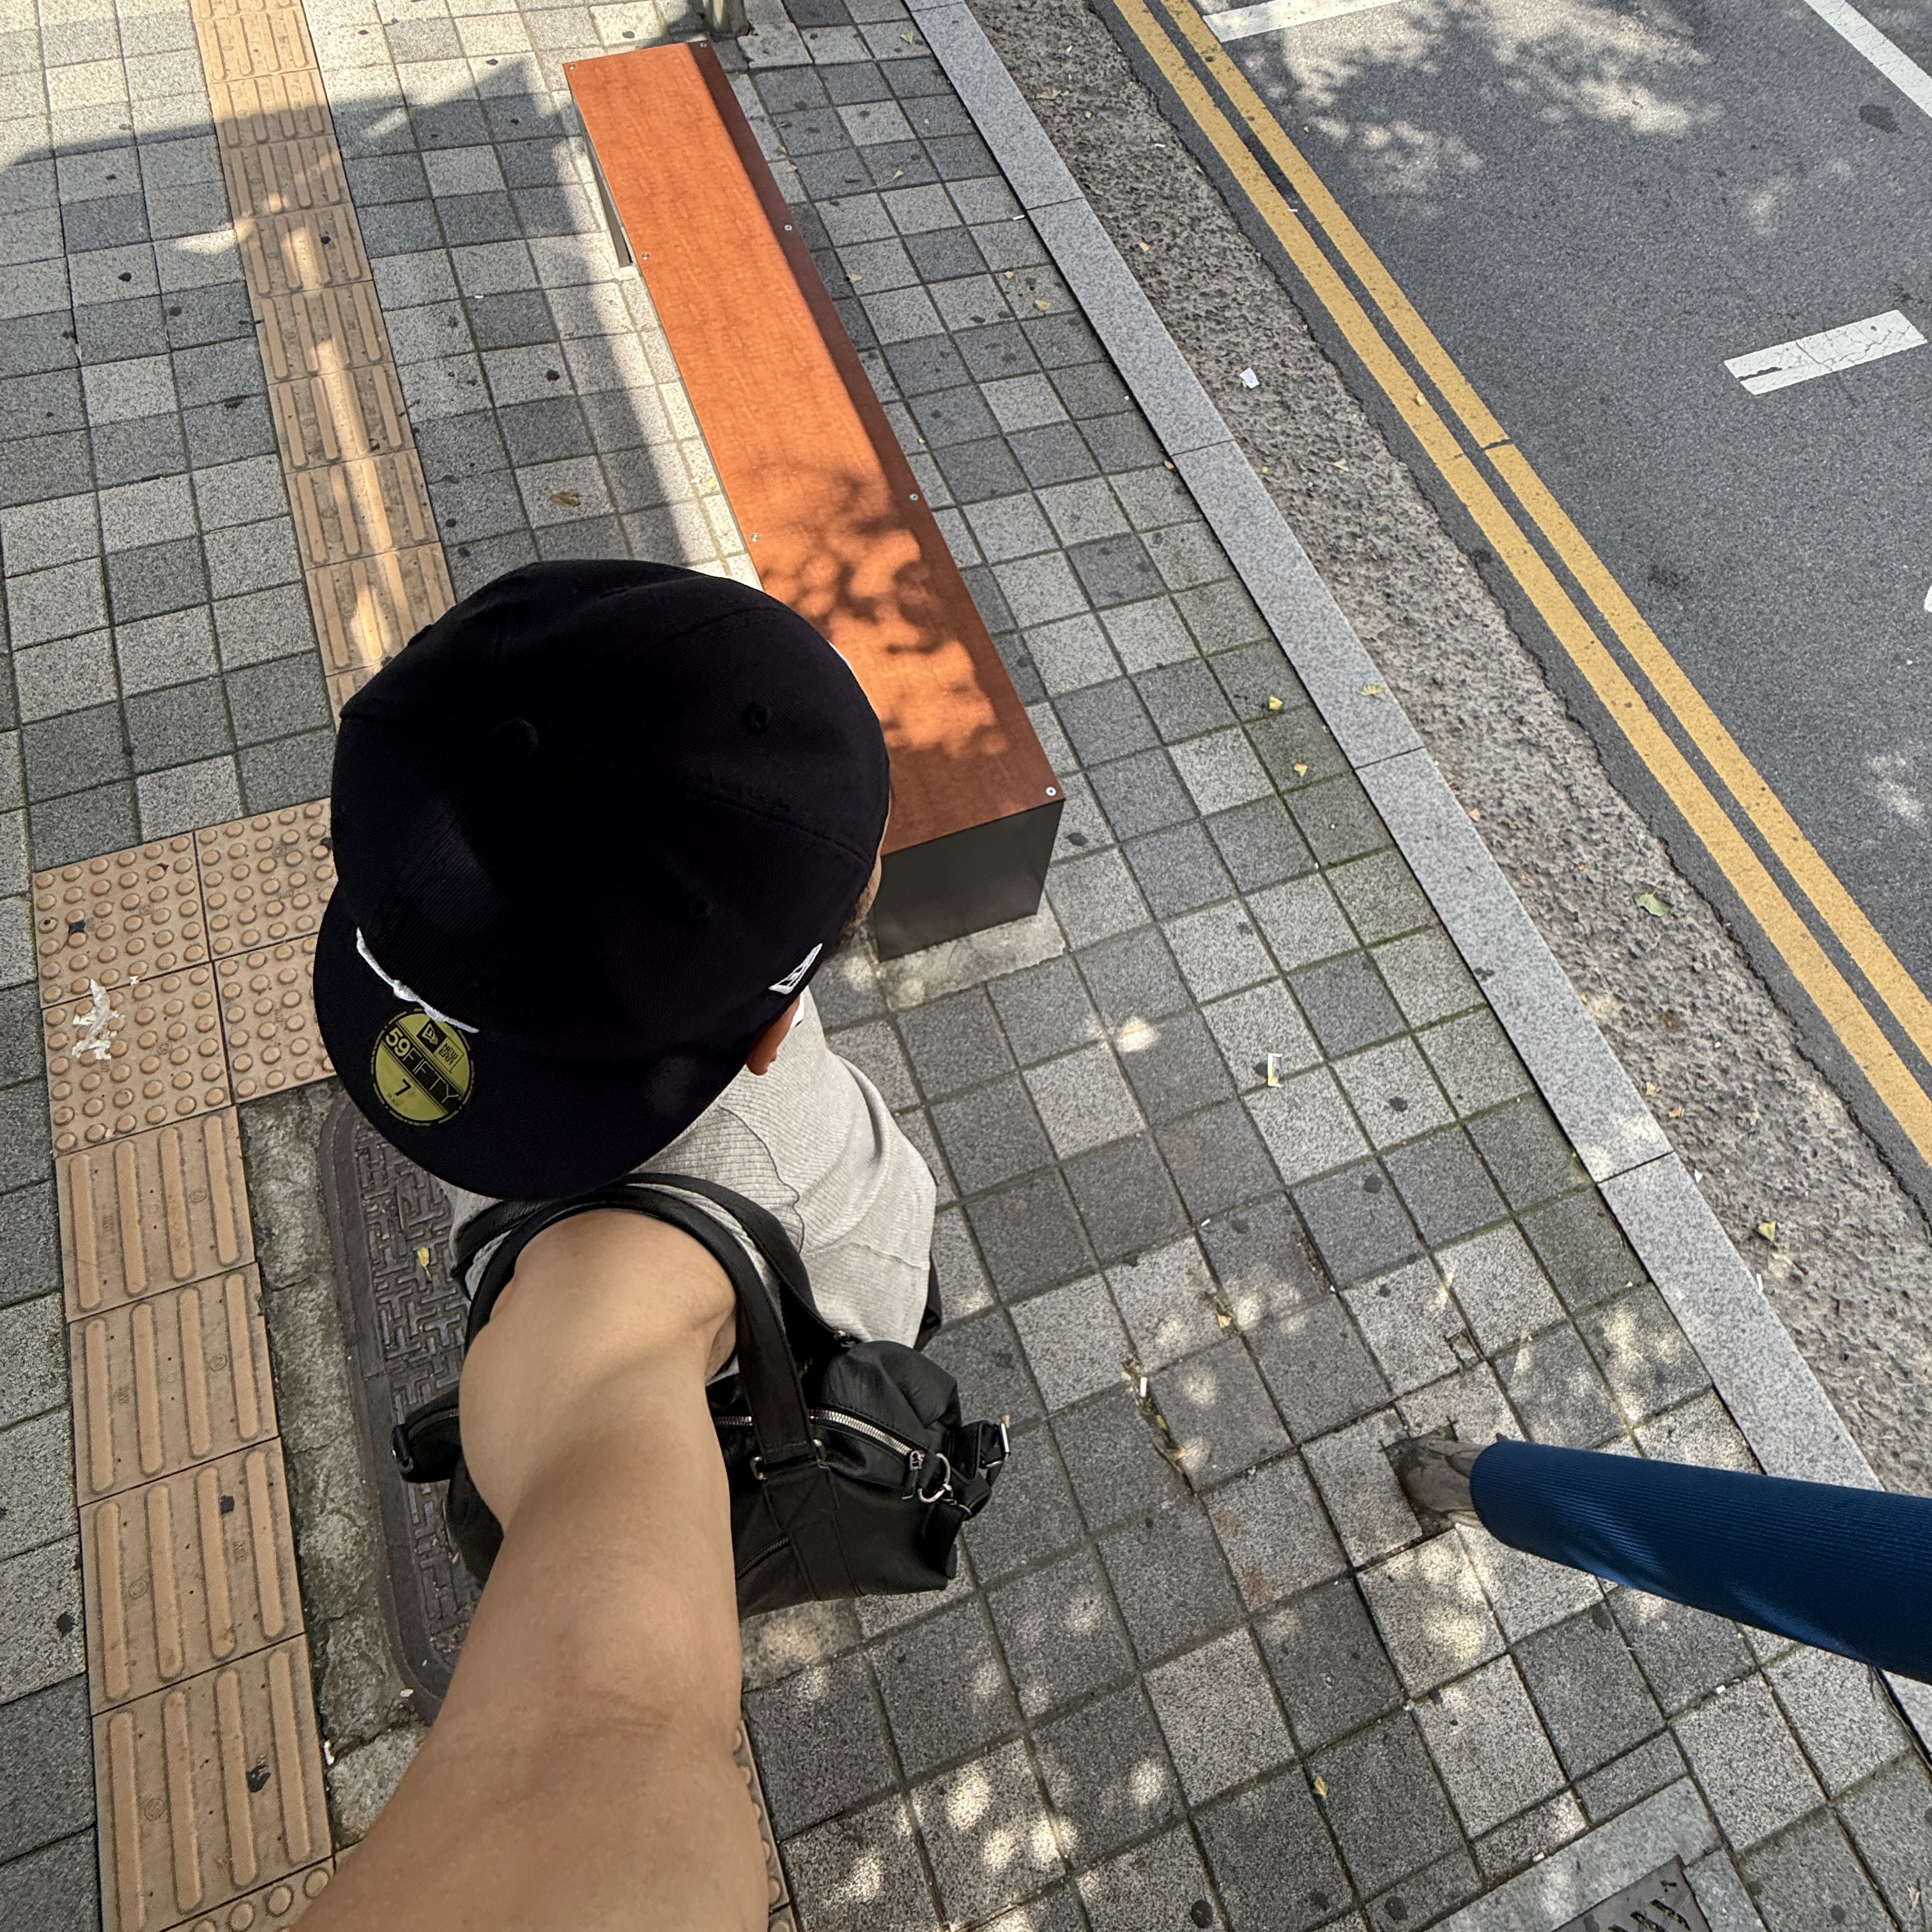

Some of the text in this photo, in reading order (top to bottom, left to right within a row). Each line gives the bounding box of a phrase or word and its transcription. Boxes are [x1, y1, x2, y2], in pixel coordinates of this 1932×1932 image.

[438, 1048, 455, 1066] ERA
[442, 1043, 459, 1060] NEW
[395, 1078, 411, 1096] 7
